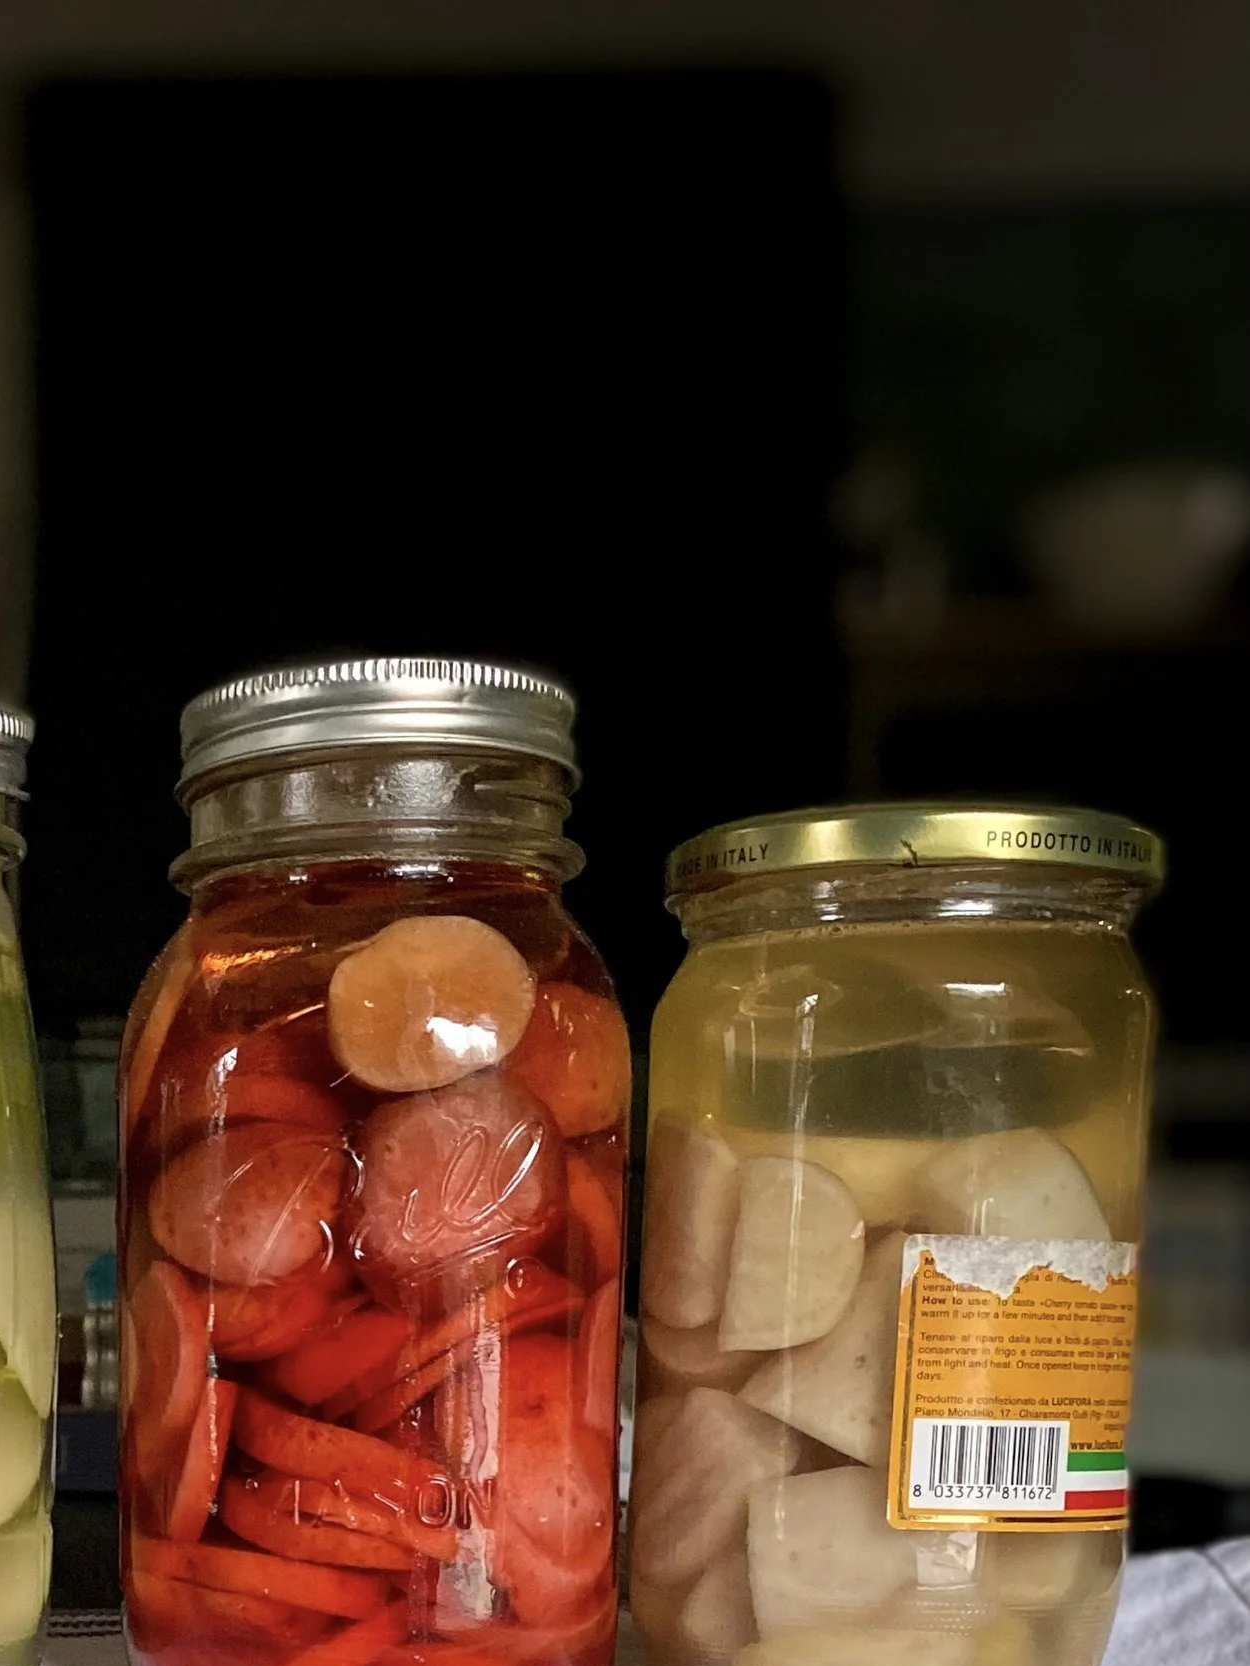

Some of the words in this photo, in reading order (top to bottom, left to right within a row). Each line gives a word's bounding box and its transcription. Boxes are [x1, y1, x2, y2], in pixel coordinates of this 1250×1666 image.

[986, 829, 1092, 854] PRODOTTO
[1097, 837, 1113, 856] IN
[706, 853, 719, 871] IN
[722, 843, 770, 868] ITALY
[219, 1121, 547, 1287] Ball
[921, 1295, 947, 1305] How
[952, 1296, 963, 1306] to
[1012, 1298, 1036, 1308] taste
[920, 1310, 950, 1319] warm
[952, 1309, 959, 1319] it
[961, 1311, 975, 1321] up
[977, 1310, 991, 1320] for
[993, 1312, 1000, 1320] a
[1002, 1310, 1018, 1320] few
[1020, 1311, 1056, 1321] minutes
[1056, 1312, 1072, 1321] and
[920, 1331, 956, 1342] Tenere
[961, 1334, 971, 1342] al
[975, 1334, 1004, 1344] riparo
[1008, 1334, 1031, 1344] dalla
[1034, 1335, 1053, 1345] luce
[1056, 1337, 1062, 1345] e
[918, 1346, 978, 1356] conservare
[981, 1347, 991, 1356] in
[994, 1347, 1017, 1359] frigo
[1020, 1349, 1027, 1357] e
[1030, 1349, 1075, 1358] consumare
[917, 1358, 942, 1368] from
[943, 1359, 966, 1370] light
[968, 1359, 988, 1368] and
[1016, 1360, 1041, 1370] Once
[1041, 1361, 1072, 1372] opened
[976, 1395, 1037, 1406] confezionato
[1038, 1397, 1049, 1406] da
[1051, 1397, 1092, 1407] LUCIFORA
[914, 1406, 945, 1417] Piano
[999, 1408, 1012, 1418] 17
[1019, 1409, 1071, 1419] Chiaramonte
[913, 1484, 922, 1498] 8
[934, 1484, 994, 1499] 033737
[1001, 1485, 1053, 1500] 811672
